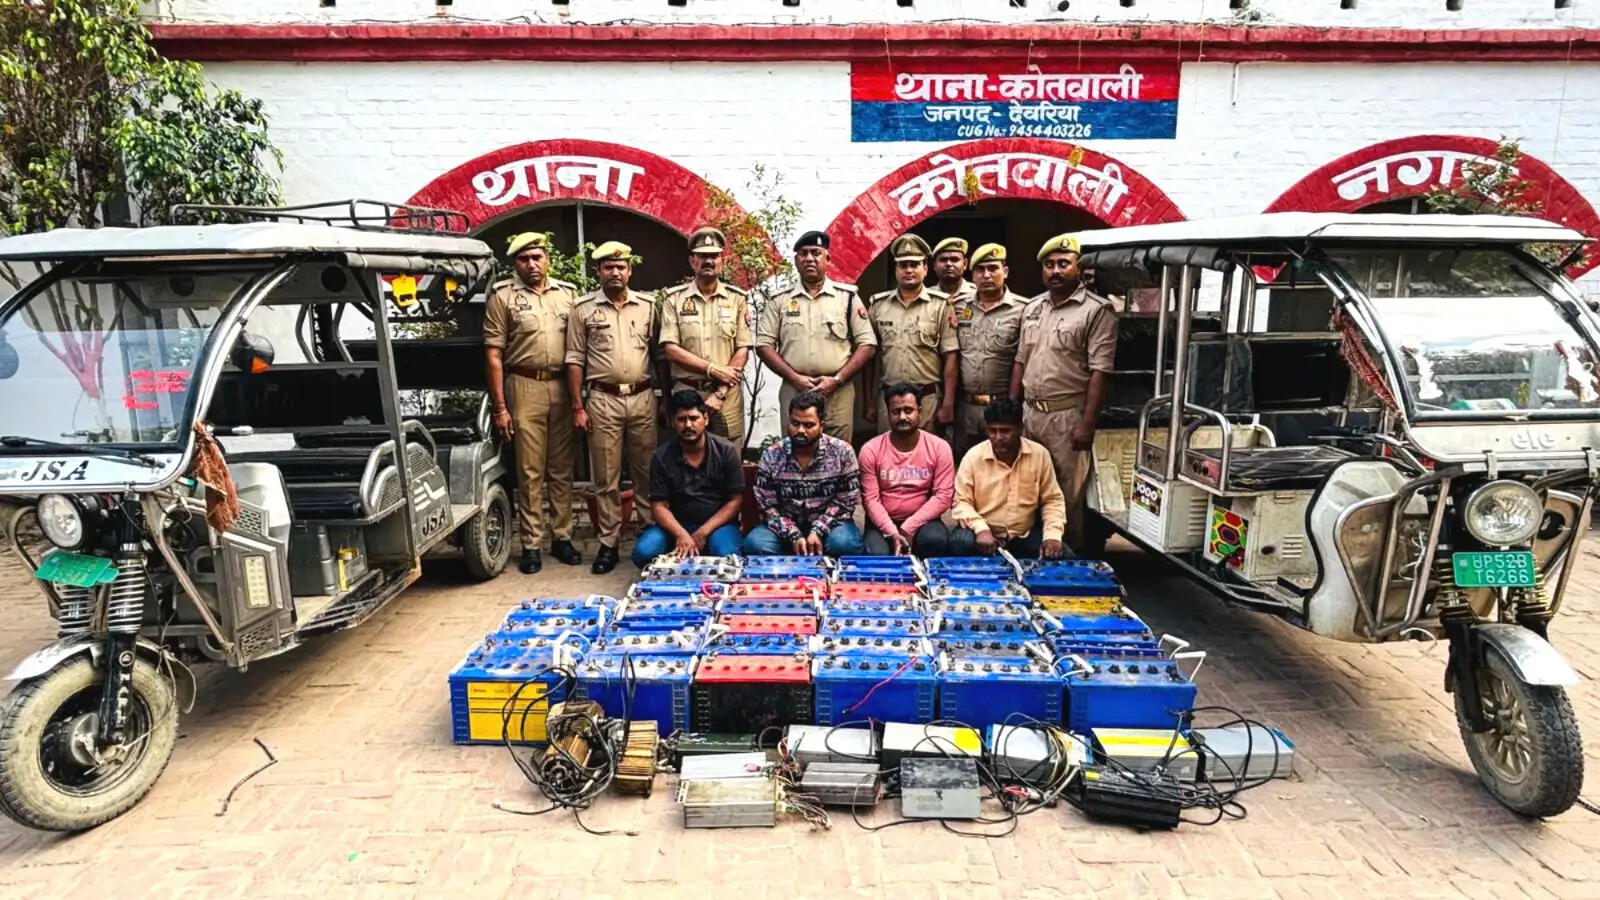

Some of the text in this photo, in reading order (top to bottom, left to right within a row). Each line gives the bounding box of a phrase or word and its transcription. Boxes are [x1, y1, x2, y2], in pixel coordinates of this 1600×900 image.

[1008, 100, 1082, 124] देवरिया
[957, 124, 984, 137] CUG
[1008, 123, 1092, 138] 9454403226
[471, 155, 646, 207] थाना
[888, 152, 1129, 217] कोतवाली
[21, 459, 90, 482] JSA
[421, 506, 447, 537] JSA
[1474, 569, 1529, 584] T6266
